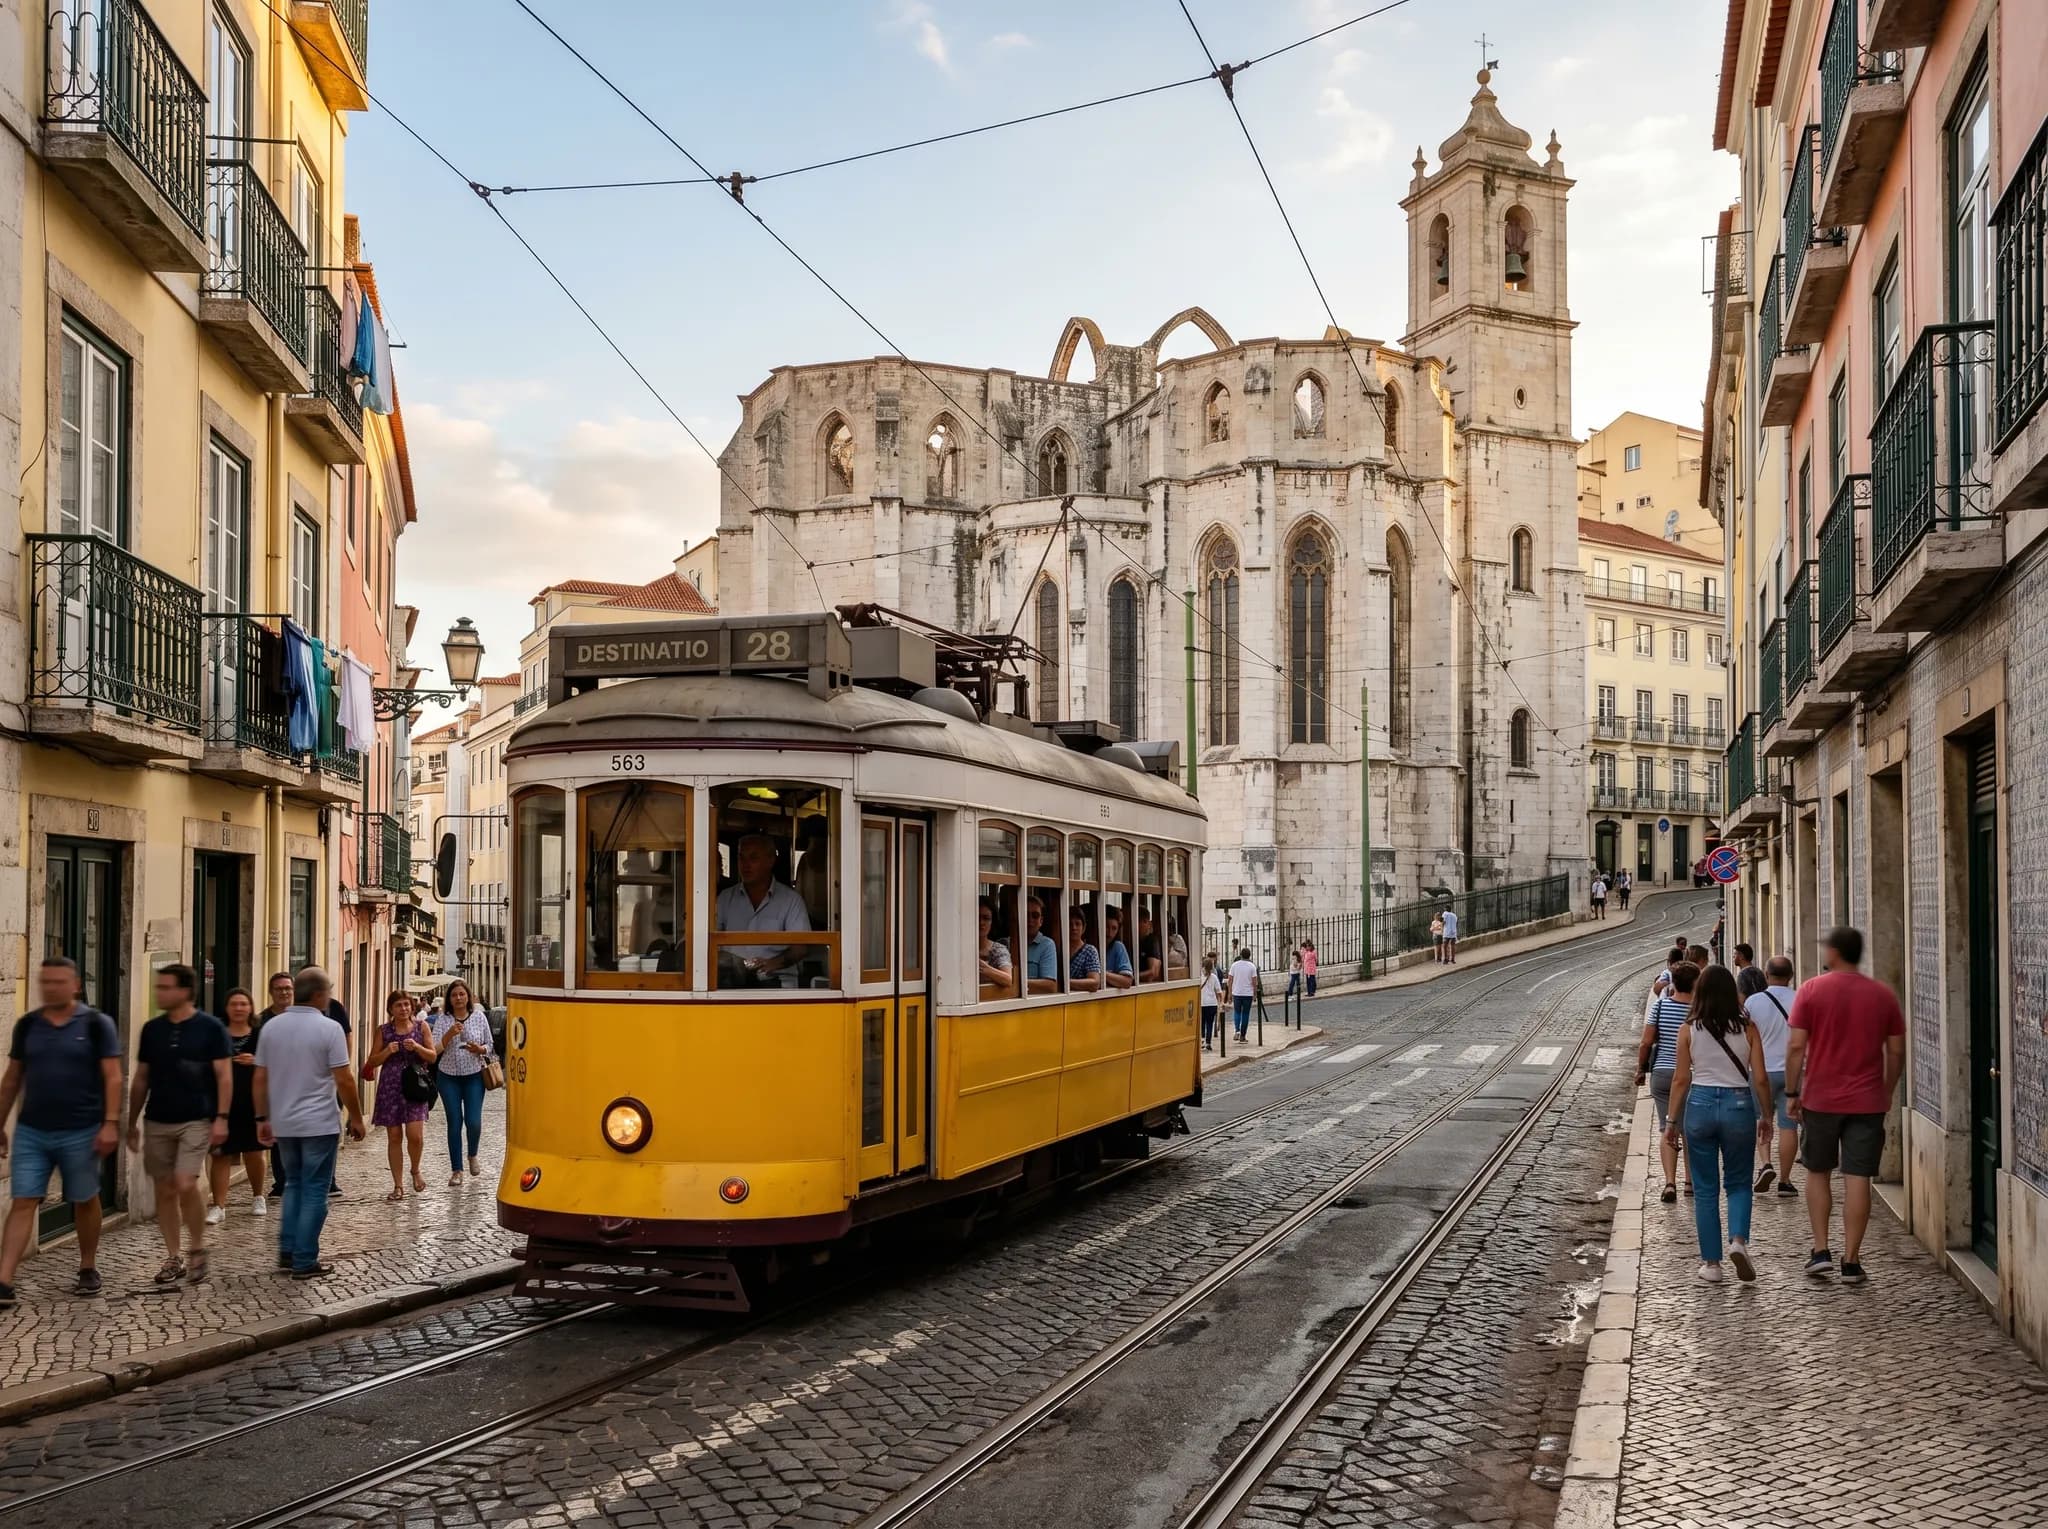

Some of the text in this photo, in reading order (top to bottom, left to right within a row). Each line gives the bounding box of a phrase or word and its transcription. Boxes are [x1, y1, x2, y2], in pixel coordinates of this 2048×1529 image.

[578, 631, 791, 663] DESTINATIO 28
[612, 754, 645, 771] 563
